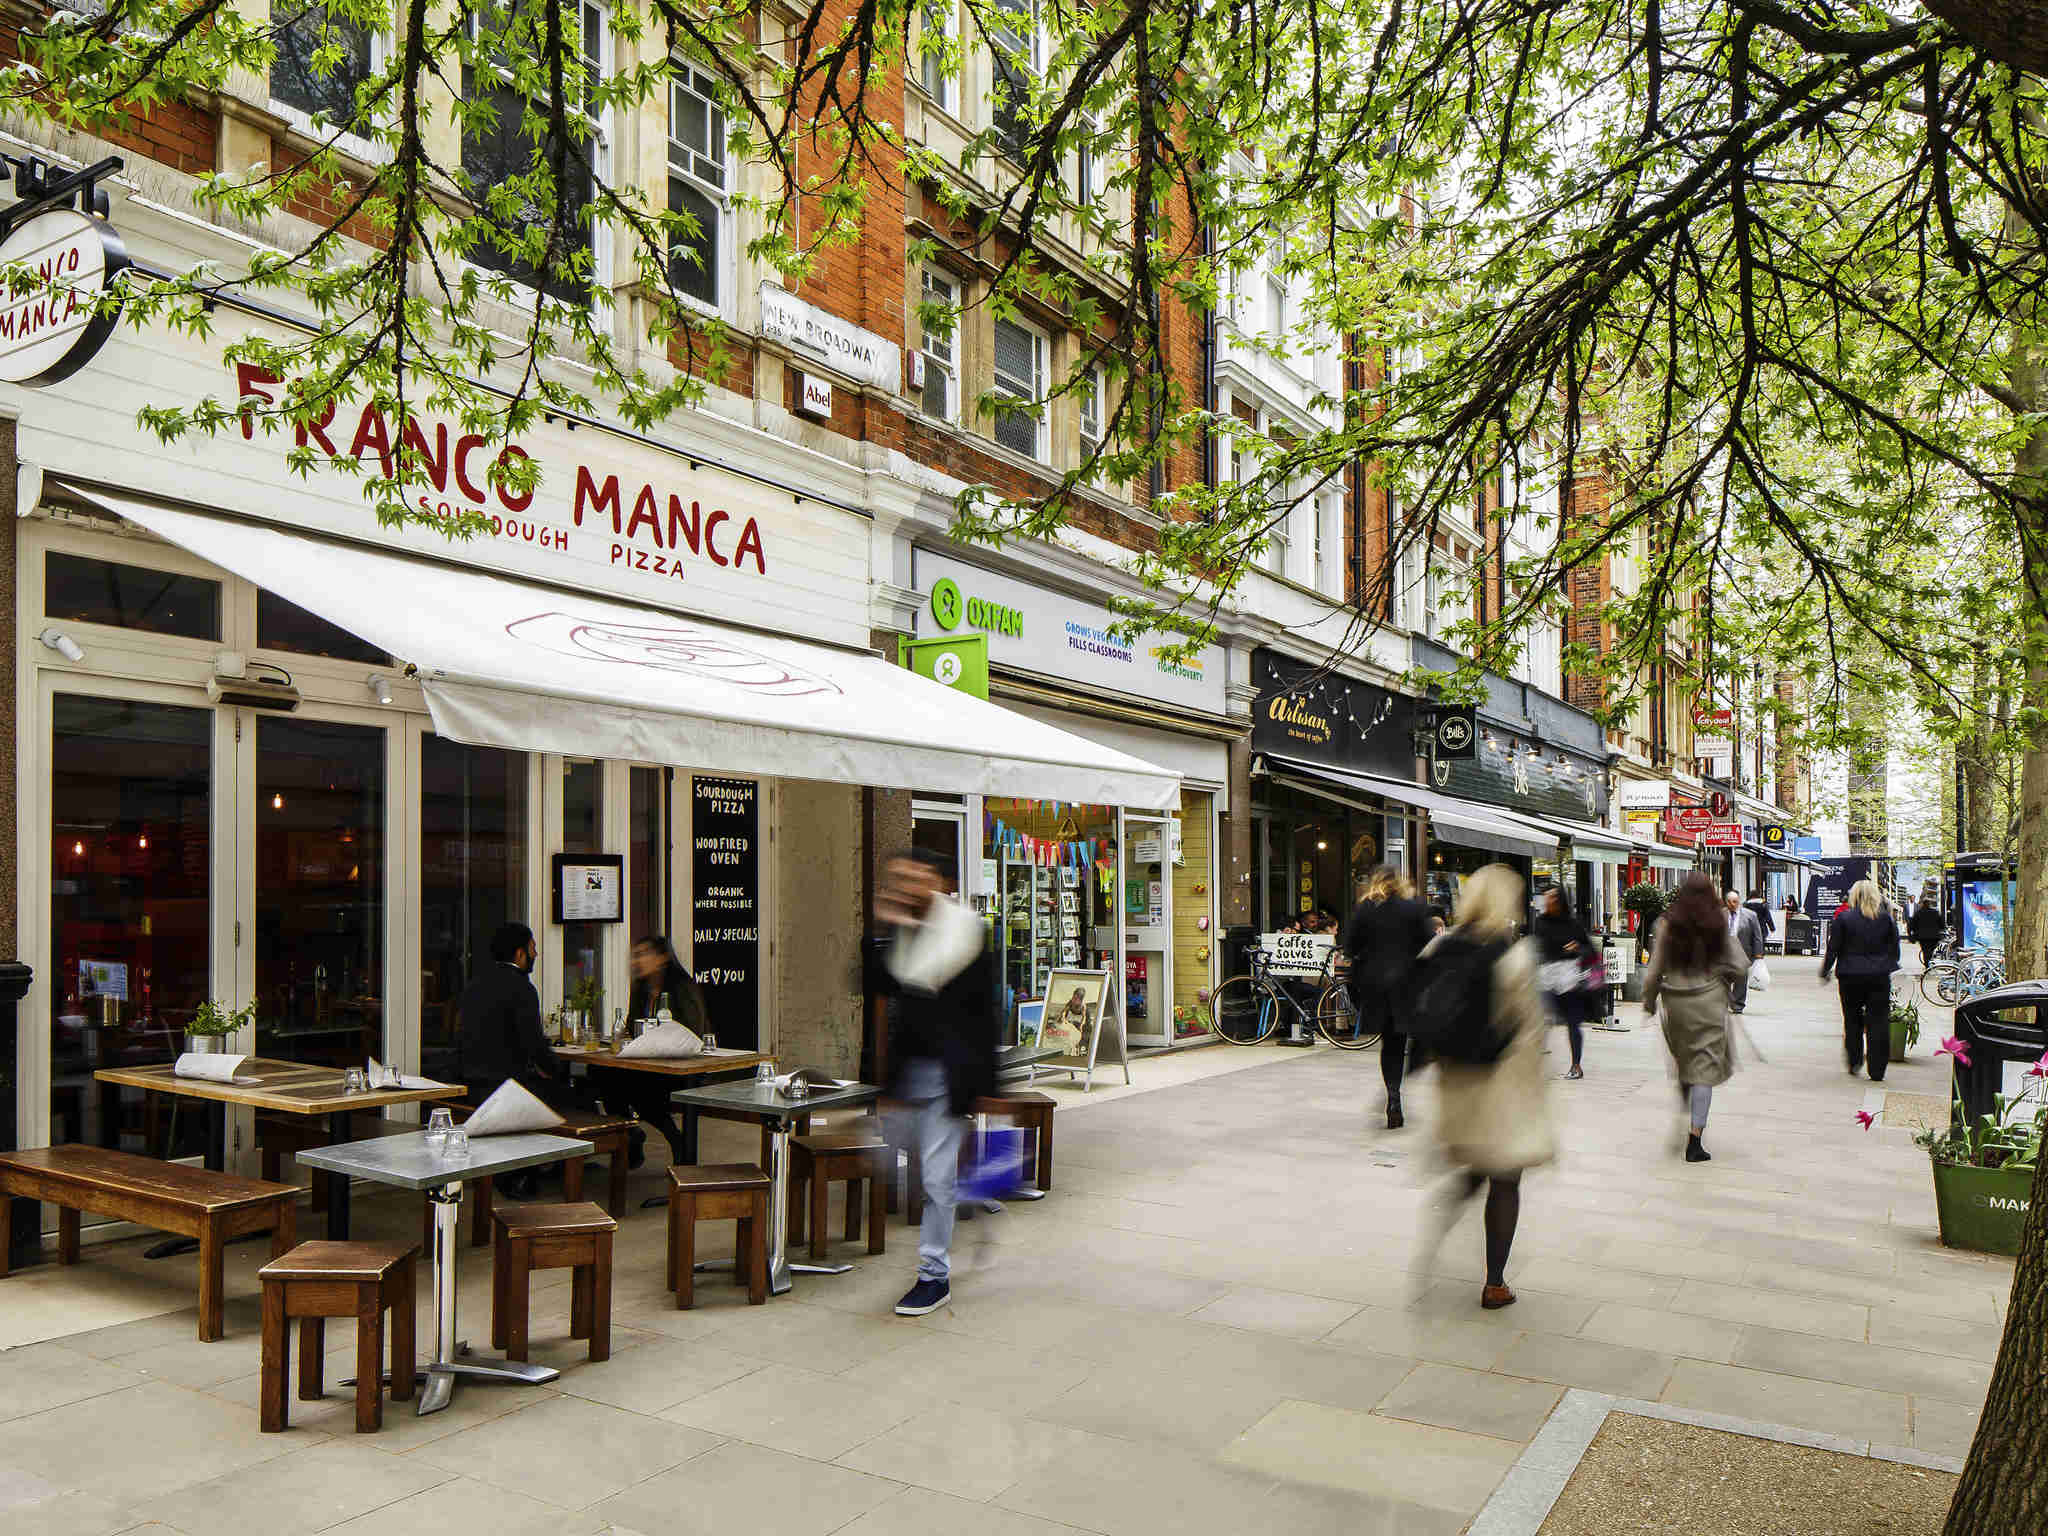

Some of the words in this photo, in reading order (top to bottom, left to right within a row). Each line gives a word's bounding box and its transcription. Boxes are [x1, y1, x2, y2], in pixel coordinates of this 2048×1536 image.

[0, 287, 77, 341] MANCA
[805, 319, 879, 366] BROADWAY
[806, 383, 831, 408] Abel
[237, 362, 536, 513] FRANCO
[573, 465, 766, 576] MANCA
[611, 543, 685, 580] PIZZA
[967, 595, 1024, 640] OXFAM
[1065, 621, 1091, 639] GROWS
[1069, 636, 1087, 651] FILLS
[1088, 642, 1132, 663] CLASSROOMS
[696, 784, 753, 800] SOURDOUGH
[711, 801, 745, 815] PIZZA
[696, 837, 718, 850] WOOD
[719, 837, 748, 851] FIRED
[710, 852, 739, 865] OVEN
[708, 886, 744, 897] ORGANIC
[695, 900, 718, 909] WHERE
[720, 899, 753, 909] POSSIBLE
[694, 927, 721, 943] DAILY
[722, 927, 758, 942] SPECIALS
[1278, 935, 1313, 949] Coffee
[695, 970, 710, 984] WE
[723, 969, 745, 983] YOU
